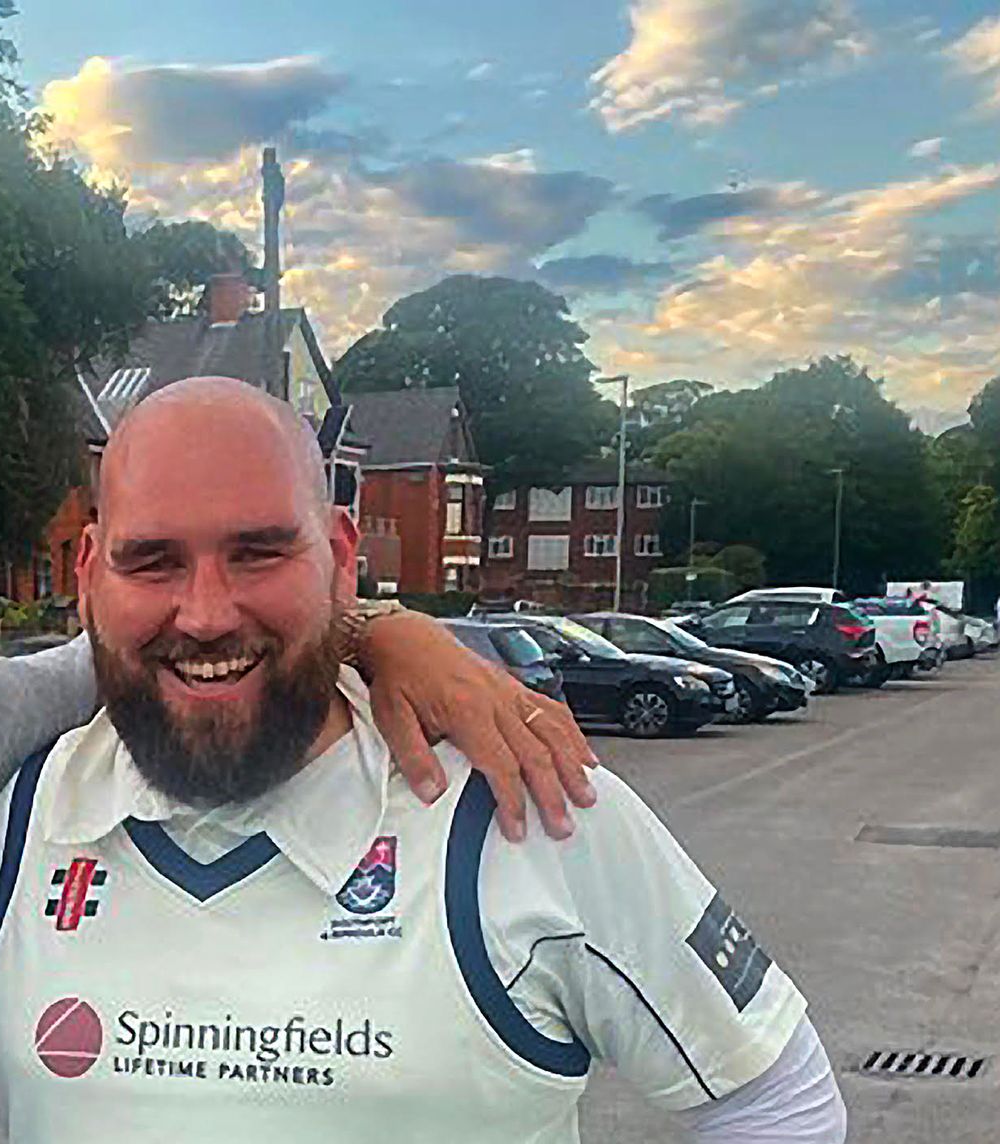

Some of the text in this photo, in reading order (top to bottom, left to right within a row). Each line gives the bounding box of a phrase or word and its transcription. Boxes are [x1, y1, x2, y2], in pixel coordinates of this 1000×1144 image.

[116, 1010, 394, 1062] Spinningfields
[114, 1057, 334, 1087] LIFETIME PARTNERS
